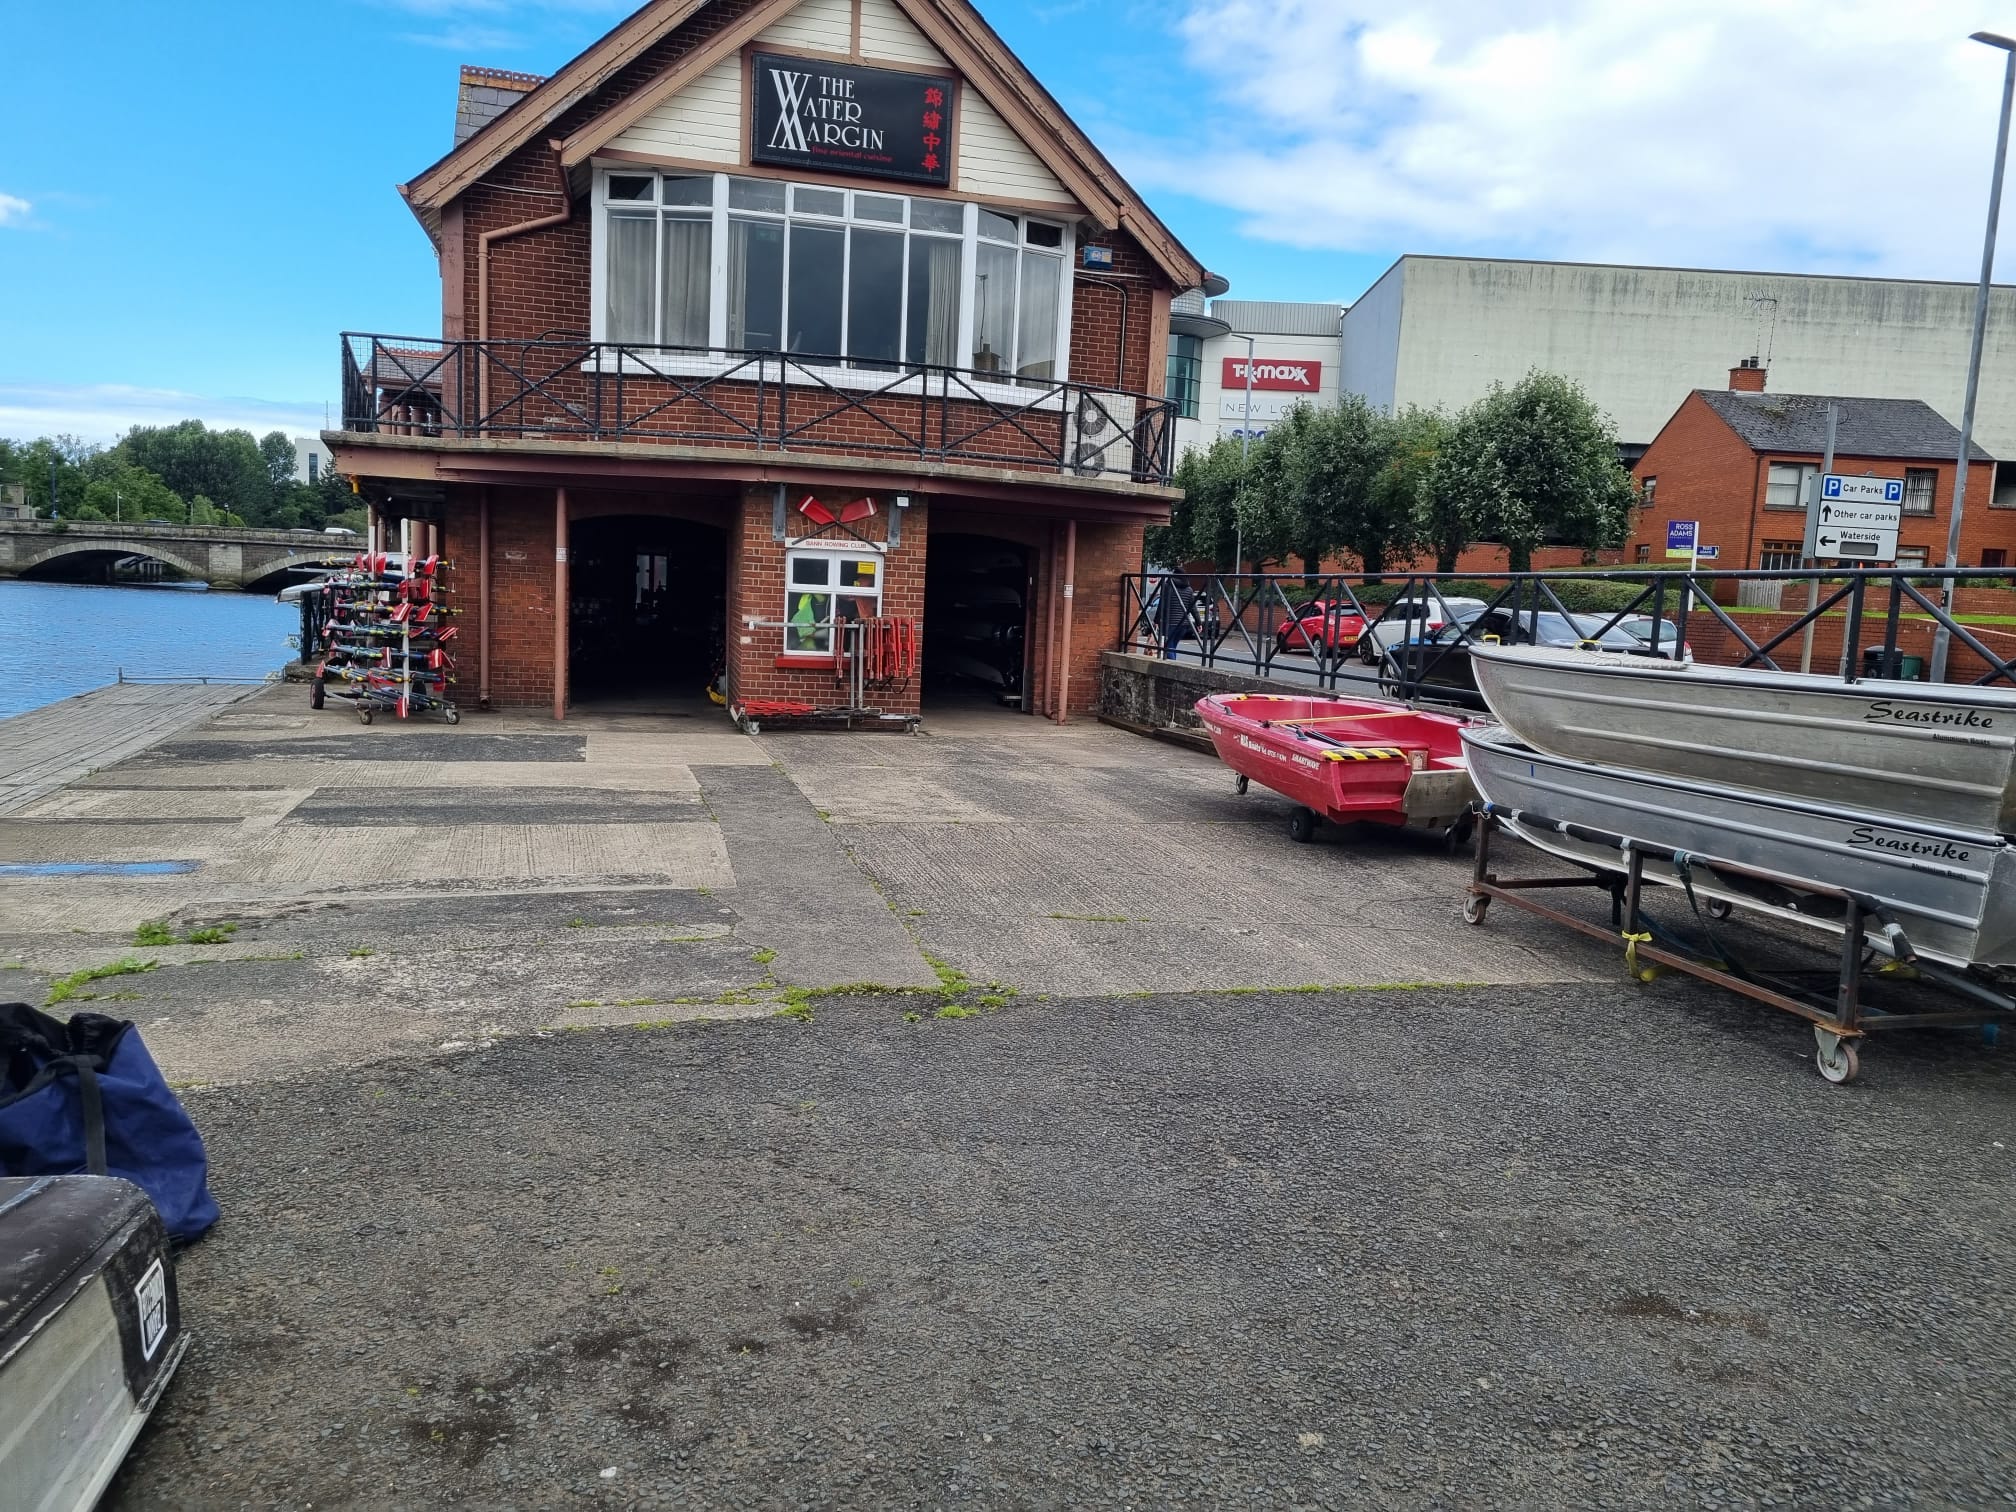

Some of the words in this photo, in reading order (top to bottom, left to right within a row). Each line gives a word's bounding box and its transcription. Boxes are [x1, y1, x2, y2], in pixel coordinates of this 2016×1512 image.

[768, 68, 862, 124] WATER
[818, 76, 855, 99] THE
[1225, 403, 1261, 414] NEW
[1843, 483, 1858, 493] Car
[1860, 485, 1883, 494] Parks
[1833, 509, 1857, 519] Other
[1875, 513, 1898, 522] parks
[1840, 530, 1881, 541] Waterside
[1864, 701, 1993, 729] Seastrike
[1846, 828, 1970, 862] Seastrike
